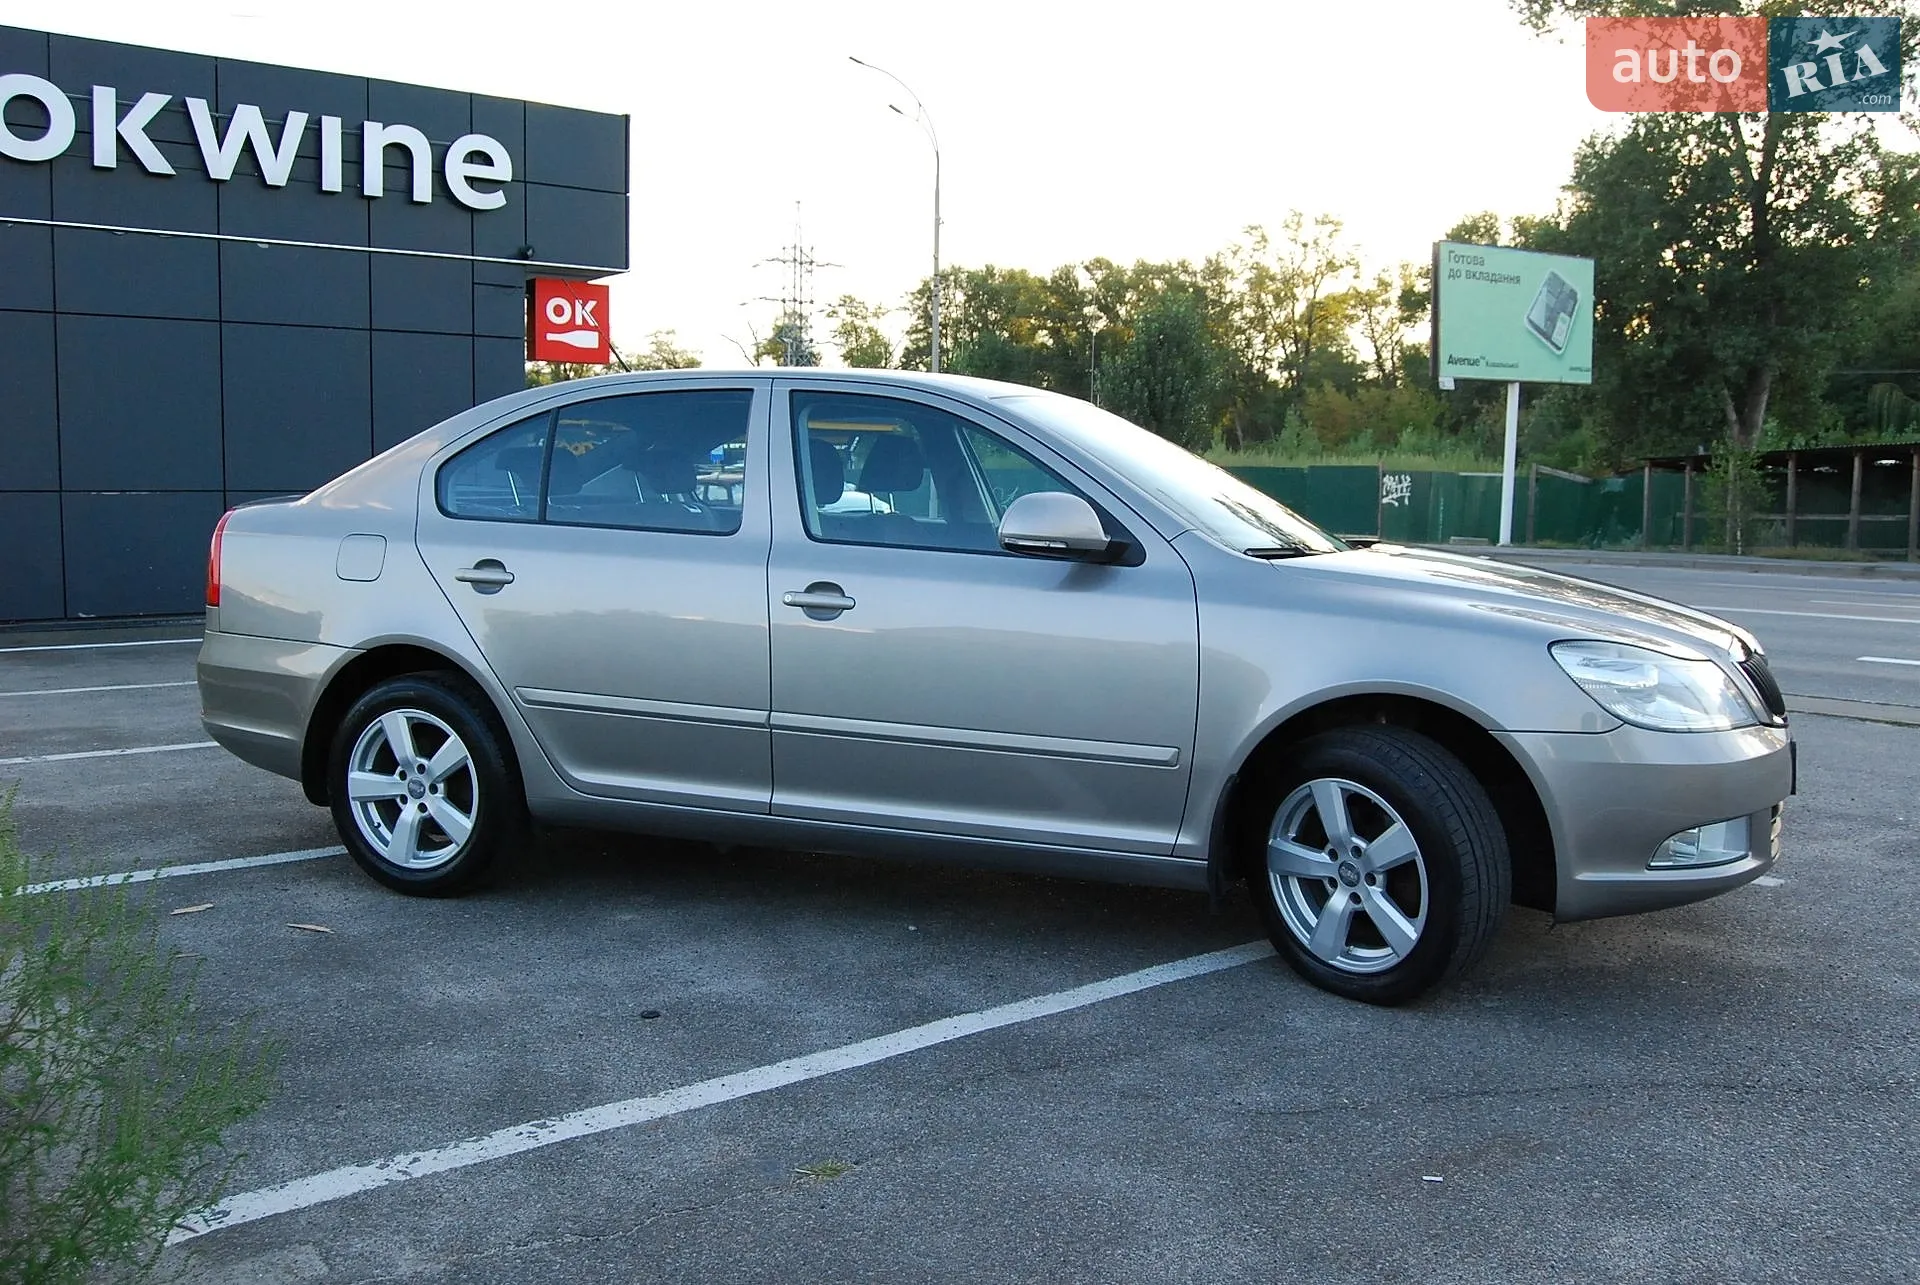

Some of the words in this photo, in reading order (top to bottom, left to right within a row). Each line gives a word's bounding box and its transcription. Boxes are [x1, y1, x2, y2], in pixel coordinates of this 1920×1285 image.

[1448, 250, 1485, 266] Готова
[1448, 268, 1462, 280] до
[1465, 269, 1521, 286] вкладання
[545, 296, 599, 327] OK
